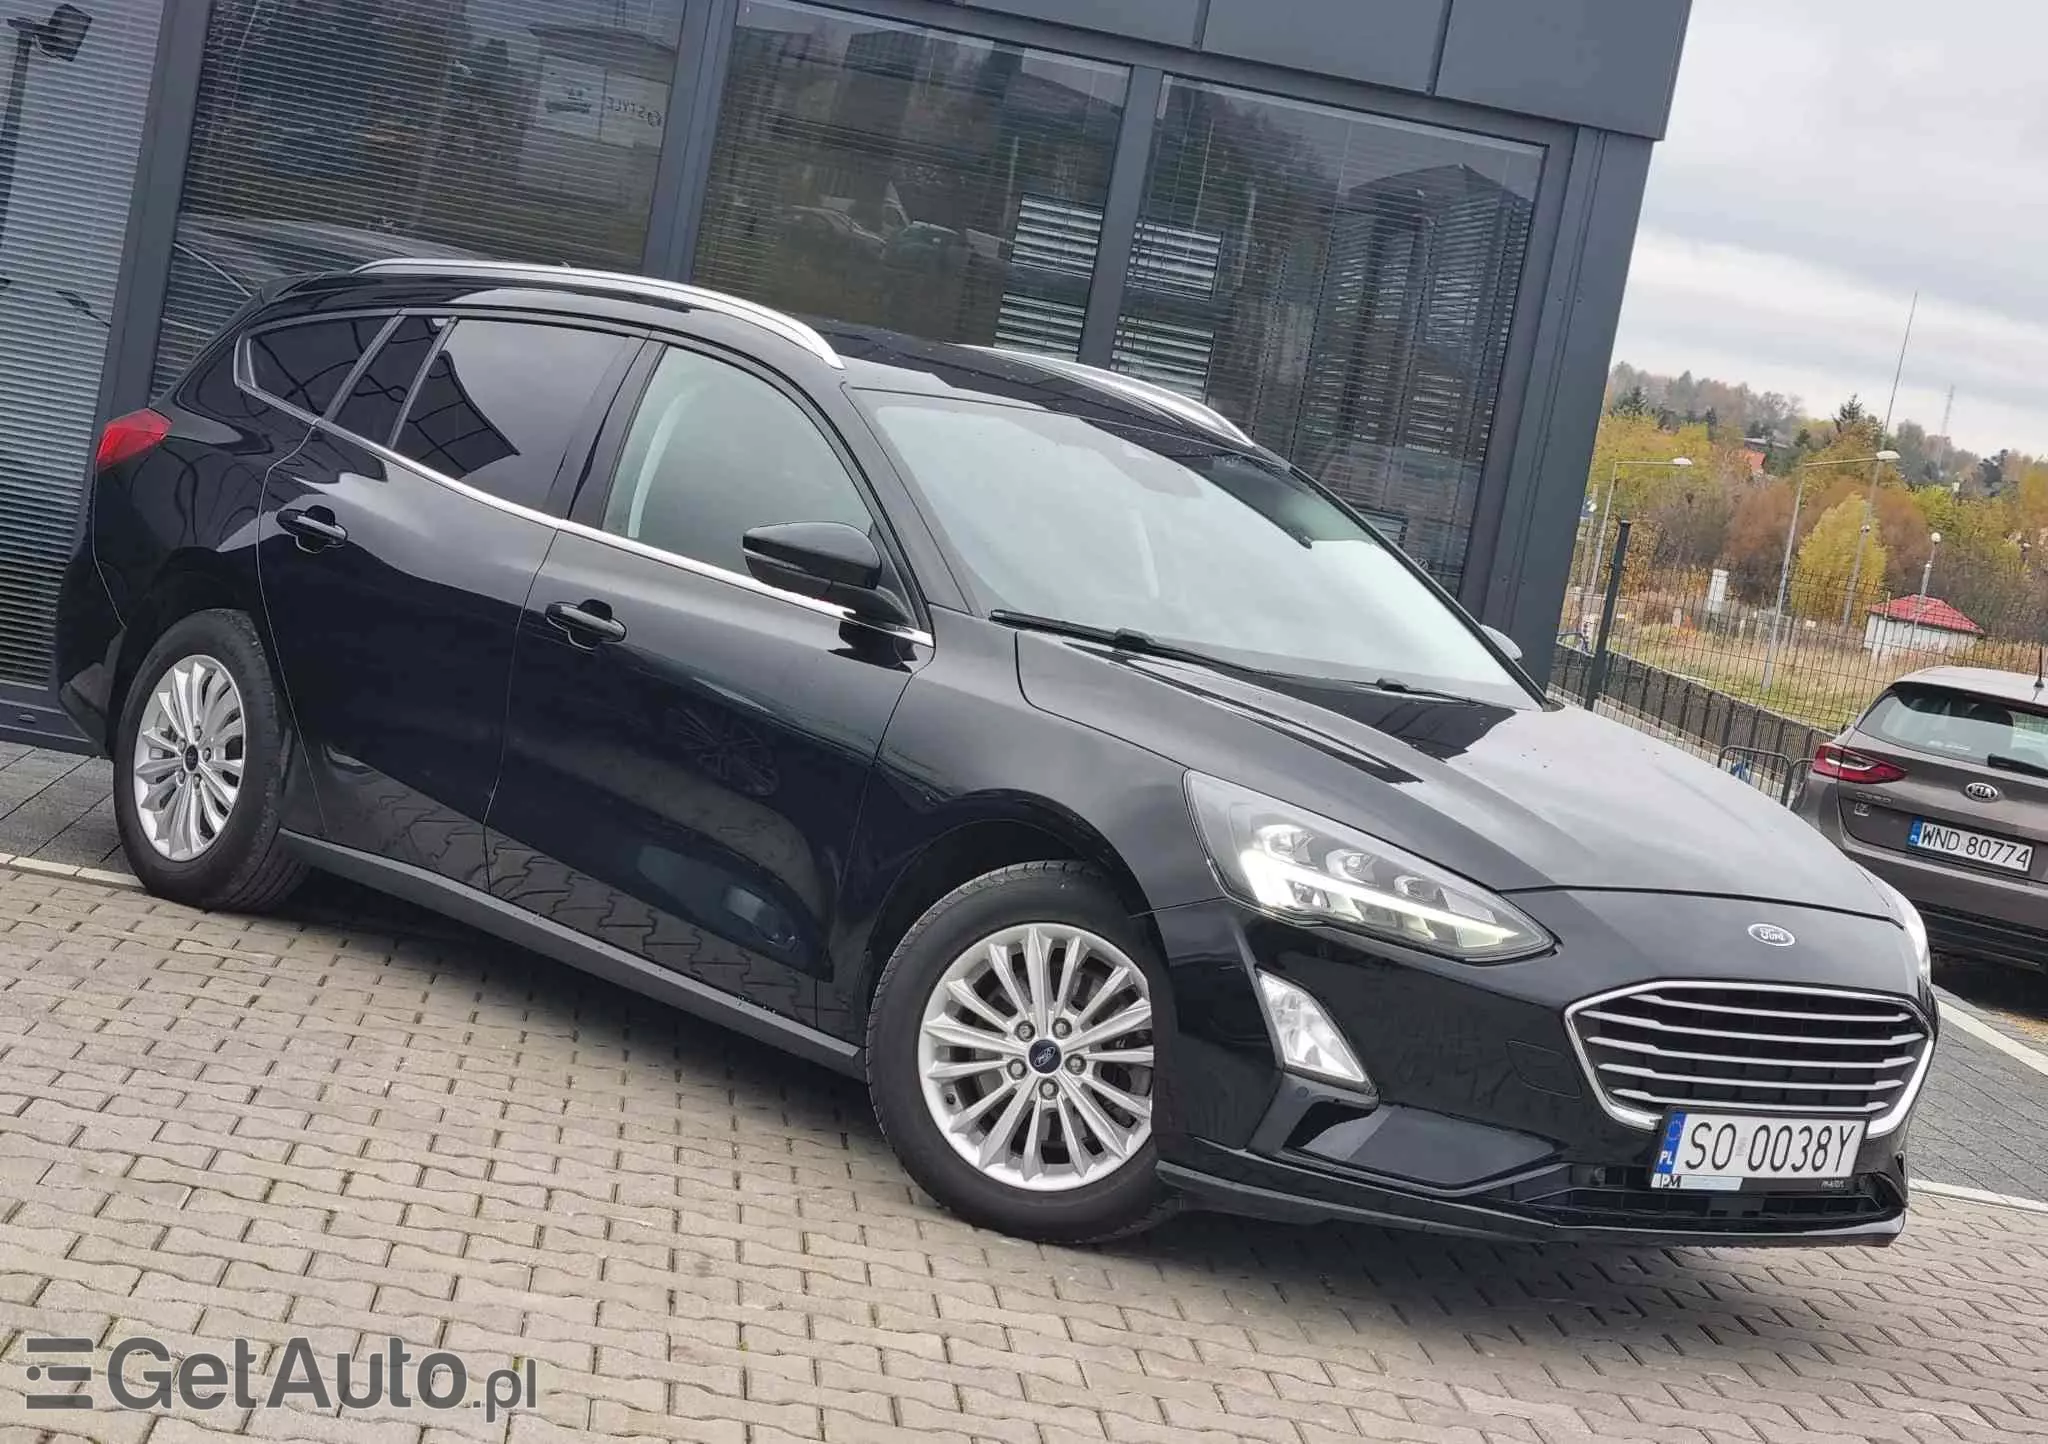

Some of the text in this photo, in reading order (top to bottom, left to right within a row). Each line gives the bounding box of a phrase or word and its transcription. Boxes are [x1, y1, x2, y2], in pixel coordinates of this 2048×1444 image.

[1971, 783, 1993, 798] KIA
[1921, 824, 2030, 868] WND 80774
[1658, 1150, 1673, 1165] PL
[1685, 1121, 1855, 1173] SO 0038Y
